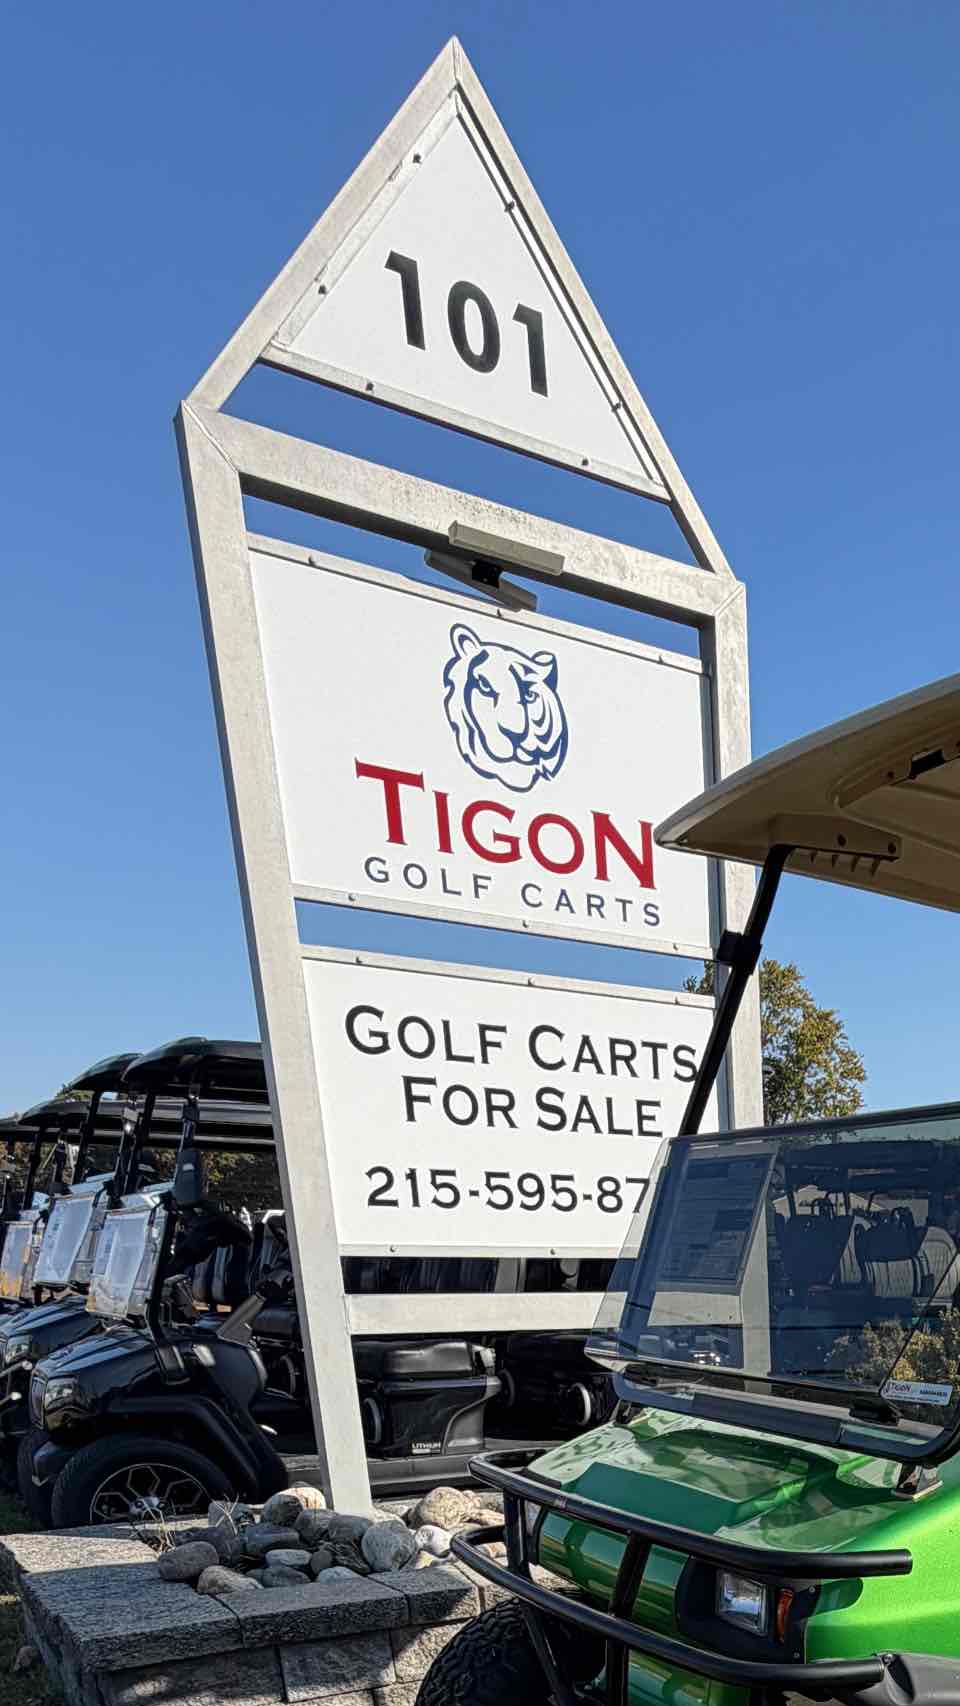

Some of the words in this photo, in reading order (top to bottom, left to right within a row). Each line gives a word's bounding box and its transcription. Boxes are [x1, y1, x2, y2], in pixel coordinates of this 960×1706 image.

[384, 250, 549, 398] 101
[354, 757, 657, 890] TIGON
[364, 856, 492, 899] GOLF
[521, 882, 662, 927] CARTS
[345, 1004, 507, 1065] GOLF
[528, 1025, 699, 1083] CARTS
[401, 1075, 518, 1129] FOR
[536, 1086, 663, 1138] SALE
